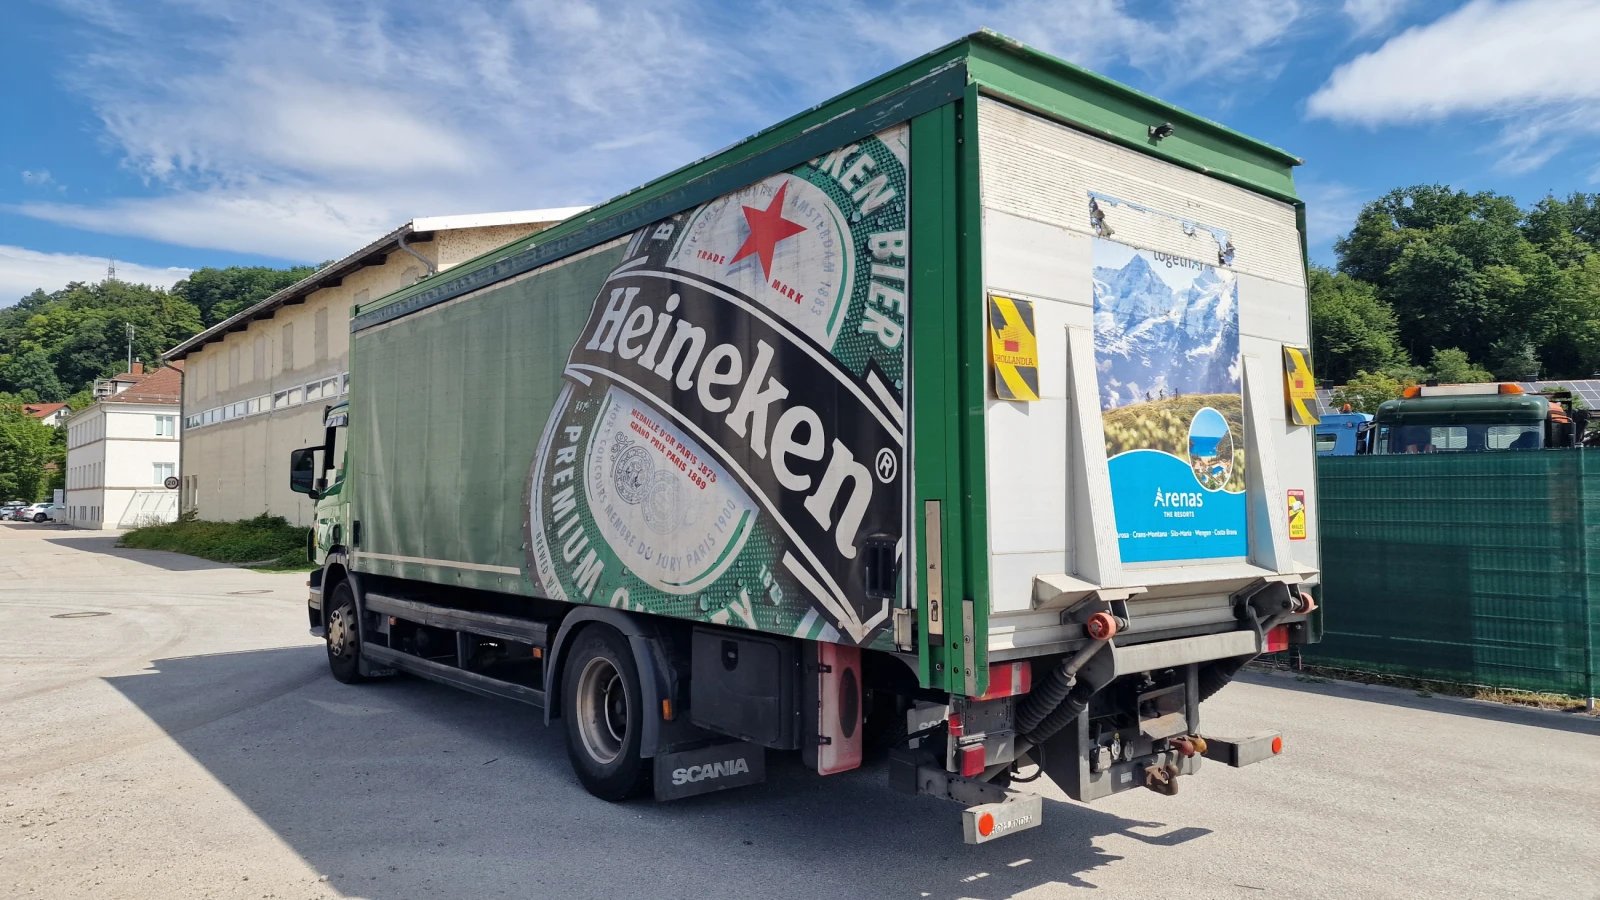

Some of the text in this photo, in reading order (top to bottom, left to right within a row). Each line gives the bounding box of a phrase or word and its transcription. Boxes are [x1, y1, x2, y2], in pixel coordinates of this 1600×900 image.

[792, 195, 836, 273] AMSTERDAM
[696, 249, 804, 305] TRADE MARK
[810, 280, 833, 317] 1883
[861, 231, 905, 348] BIER
[585, 286, 873, 559] Heineken
[630, 407, 718, 484] MEDAILLE D'OR PARIS 1875
[630, 420, 708, 491] GRAND PRIX PARIS 1889
[551, 425, 605, 599] PREMIUM
[594, 439, 608, 504] CONCOURS
[604, 503, 637, 548] MEMBRE
[637, 541, 654, 560] DU
[655, 552, 682, 572] JURY
[686, 532, 716, 568] PARIS
[713, 498, 736, 534] 1900
[1153, 487, 1204, 508] Arenas
[535, 532, 549, 575] BREWED
[671, 757, 750, 786] SCANIA
